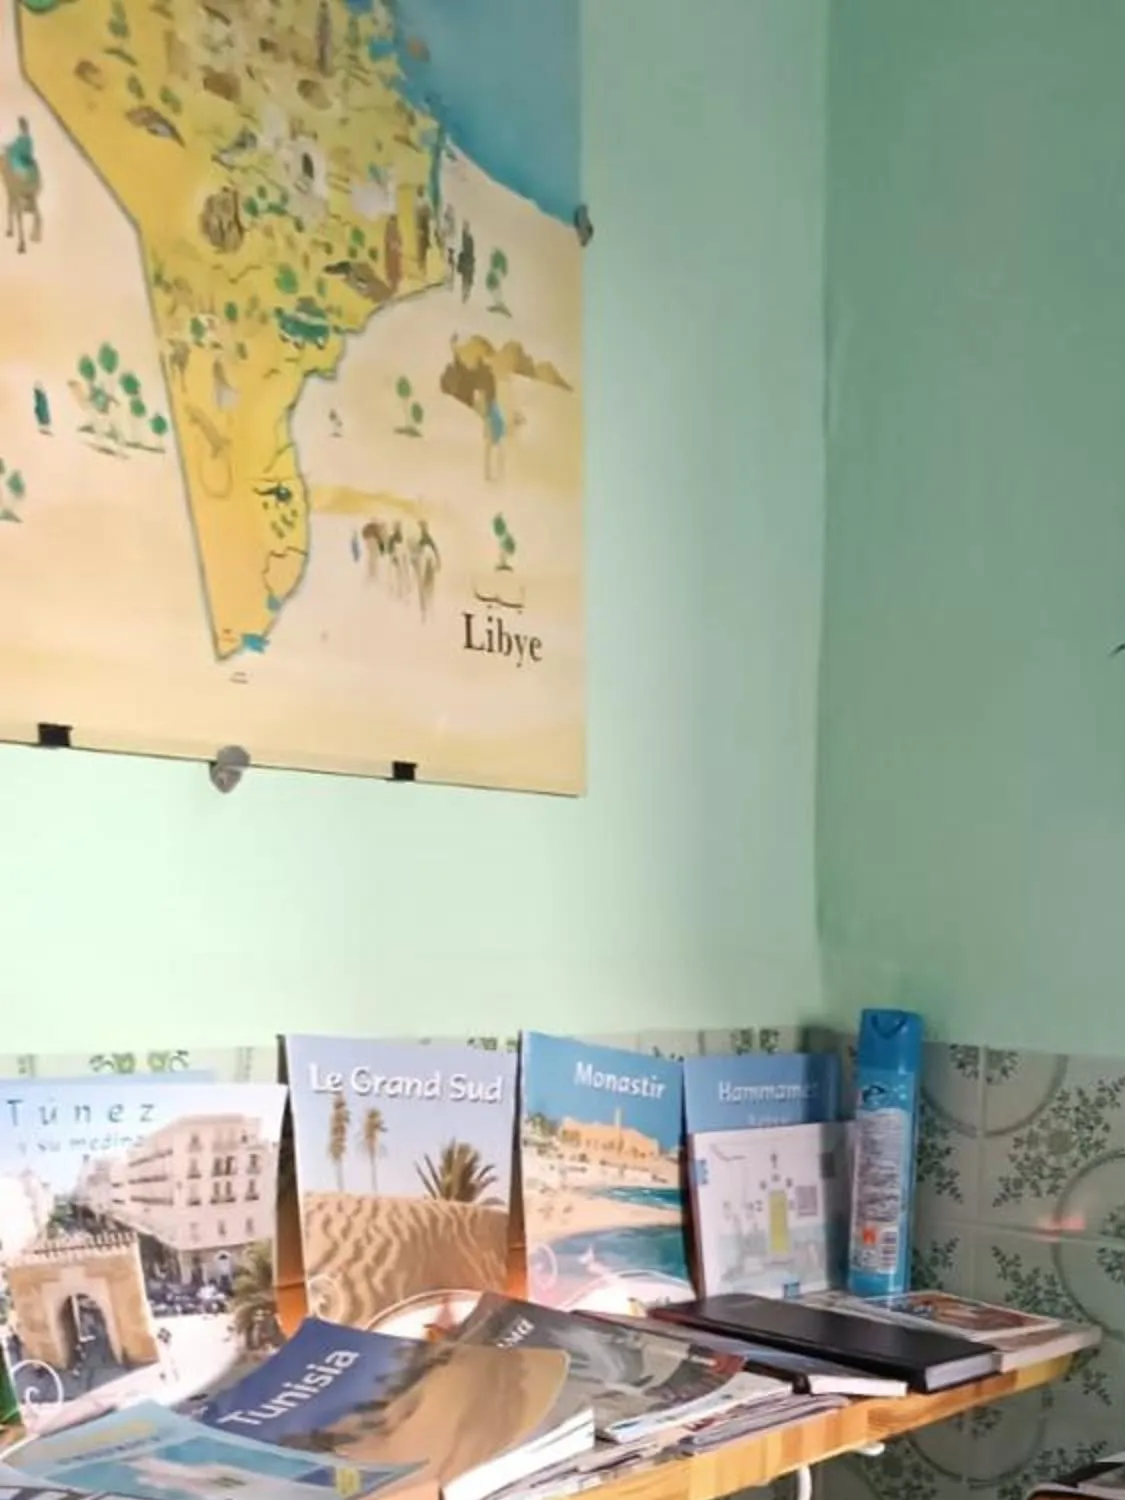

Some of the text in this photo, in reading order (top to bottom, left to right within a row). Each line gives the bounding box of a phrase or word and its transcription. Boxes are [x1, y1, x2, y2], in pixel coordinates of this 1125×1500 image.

[461, 612, 543, 669] Libye
[308, 1063, 505, 1104] Le Grand Sud
[573, 1060, 668, 1100] Monastir
[217, 1346, 361, 1427] Tunisia
